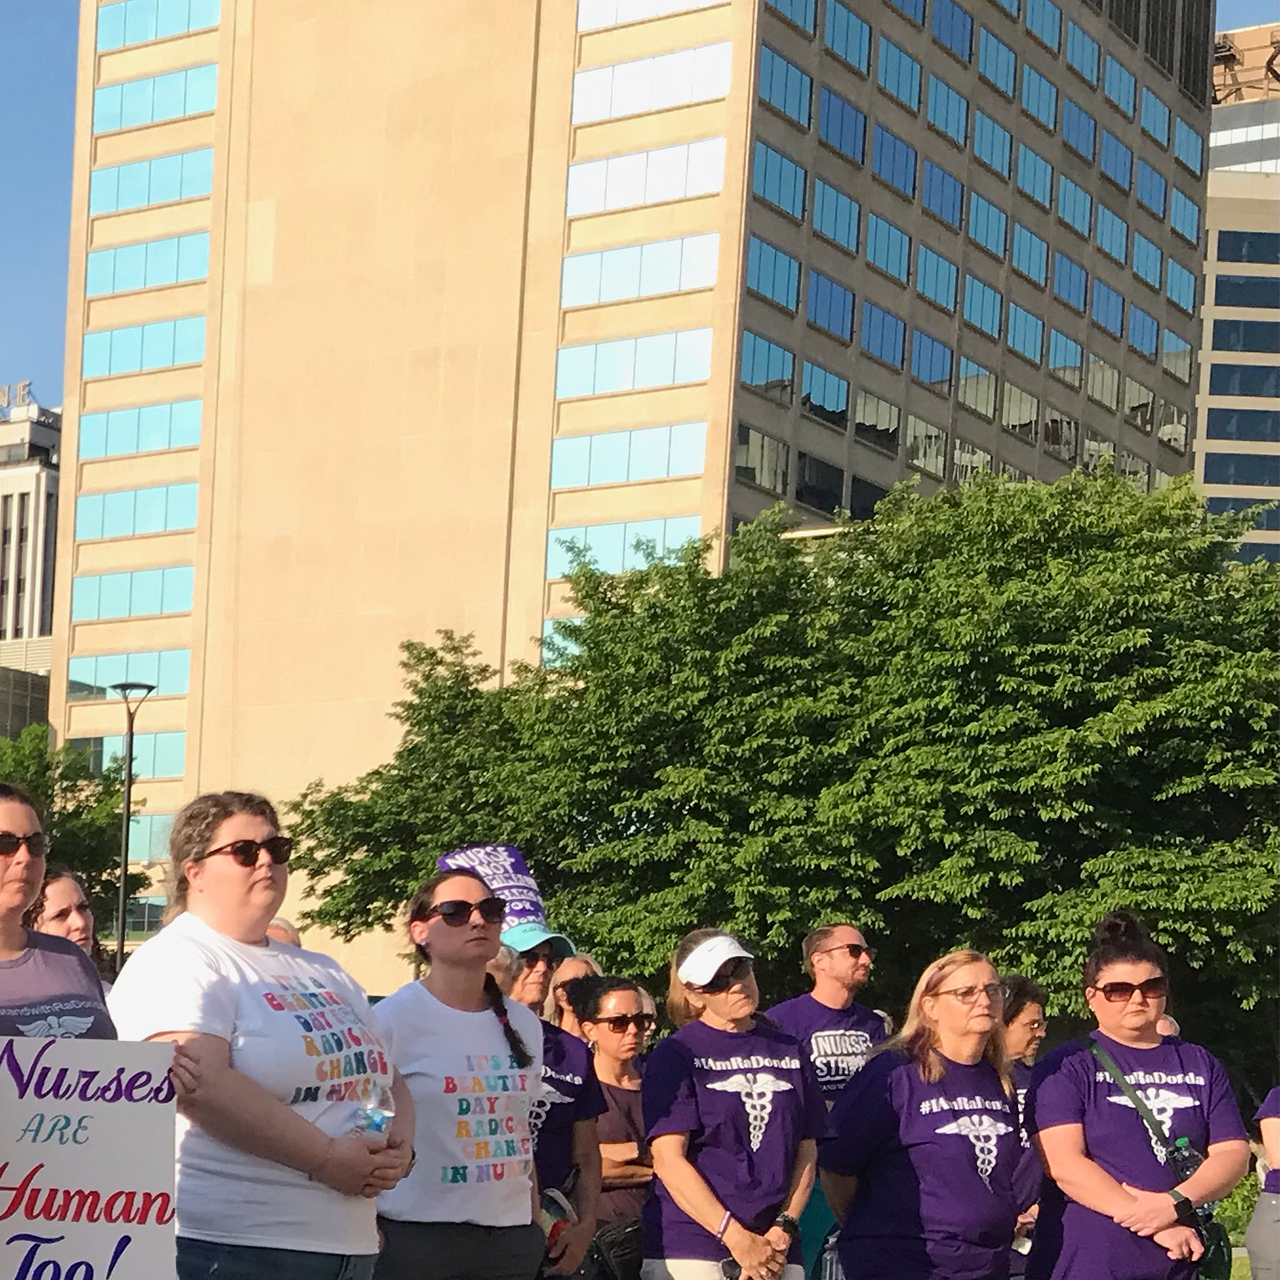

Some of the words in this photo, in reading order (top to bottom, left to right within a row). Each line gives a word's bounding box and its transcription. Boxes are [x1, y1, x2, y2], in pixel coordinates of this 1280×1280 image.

[445, 846, 516, 870] NURSE
[475, 861, 514, 877] NOT
[262, 991, 351, 1012] BEAUTIF
[294, 1011, 333, 1033] DAY
[817, 1035, 867, 1055] NURSE
[315, 1049, 388, 1082] CHANGE
[693, 1055, 801, 1071] #IAmRaDonda
[443, 1073, 541, 1094] BEAUTIF
[1095, 1071, 1206, 1086] #ImRaDonda
[290, 1085, 322, 1105] IN
[325, 1078, 377, 1102] NURS
[457, 1096, 500, 1116] DAY
[920, 1096, 1011, 1115] #IAmRaDona
[15, 1113, 94, 1146] ARE
[455, 1116, 529, 1139] RADICA
[441, 1165, 469, 1184] IN
